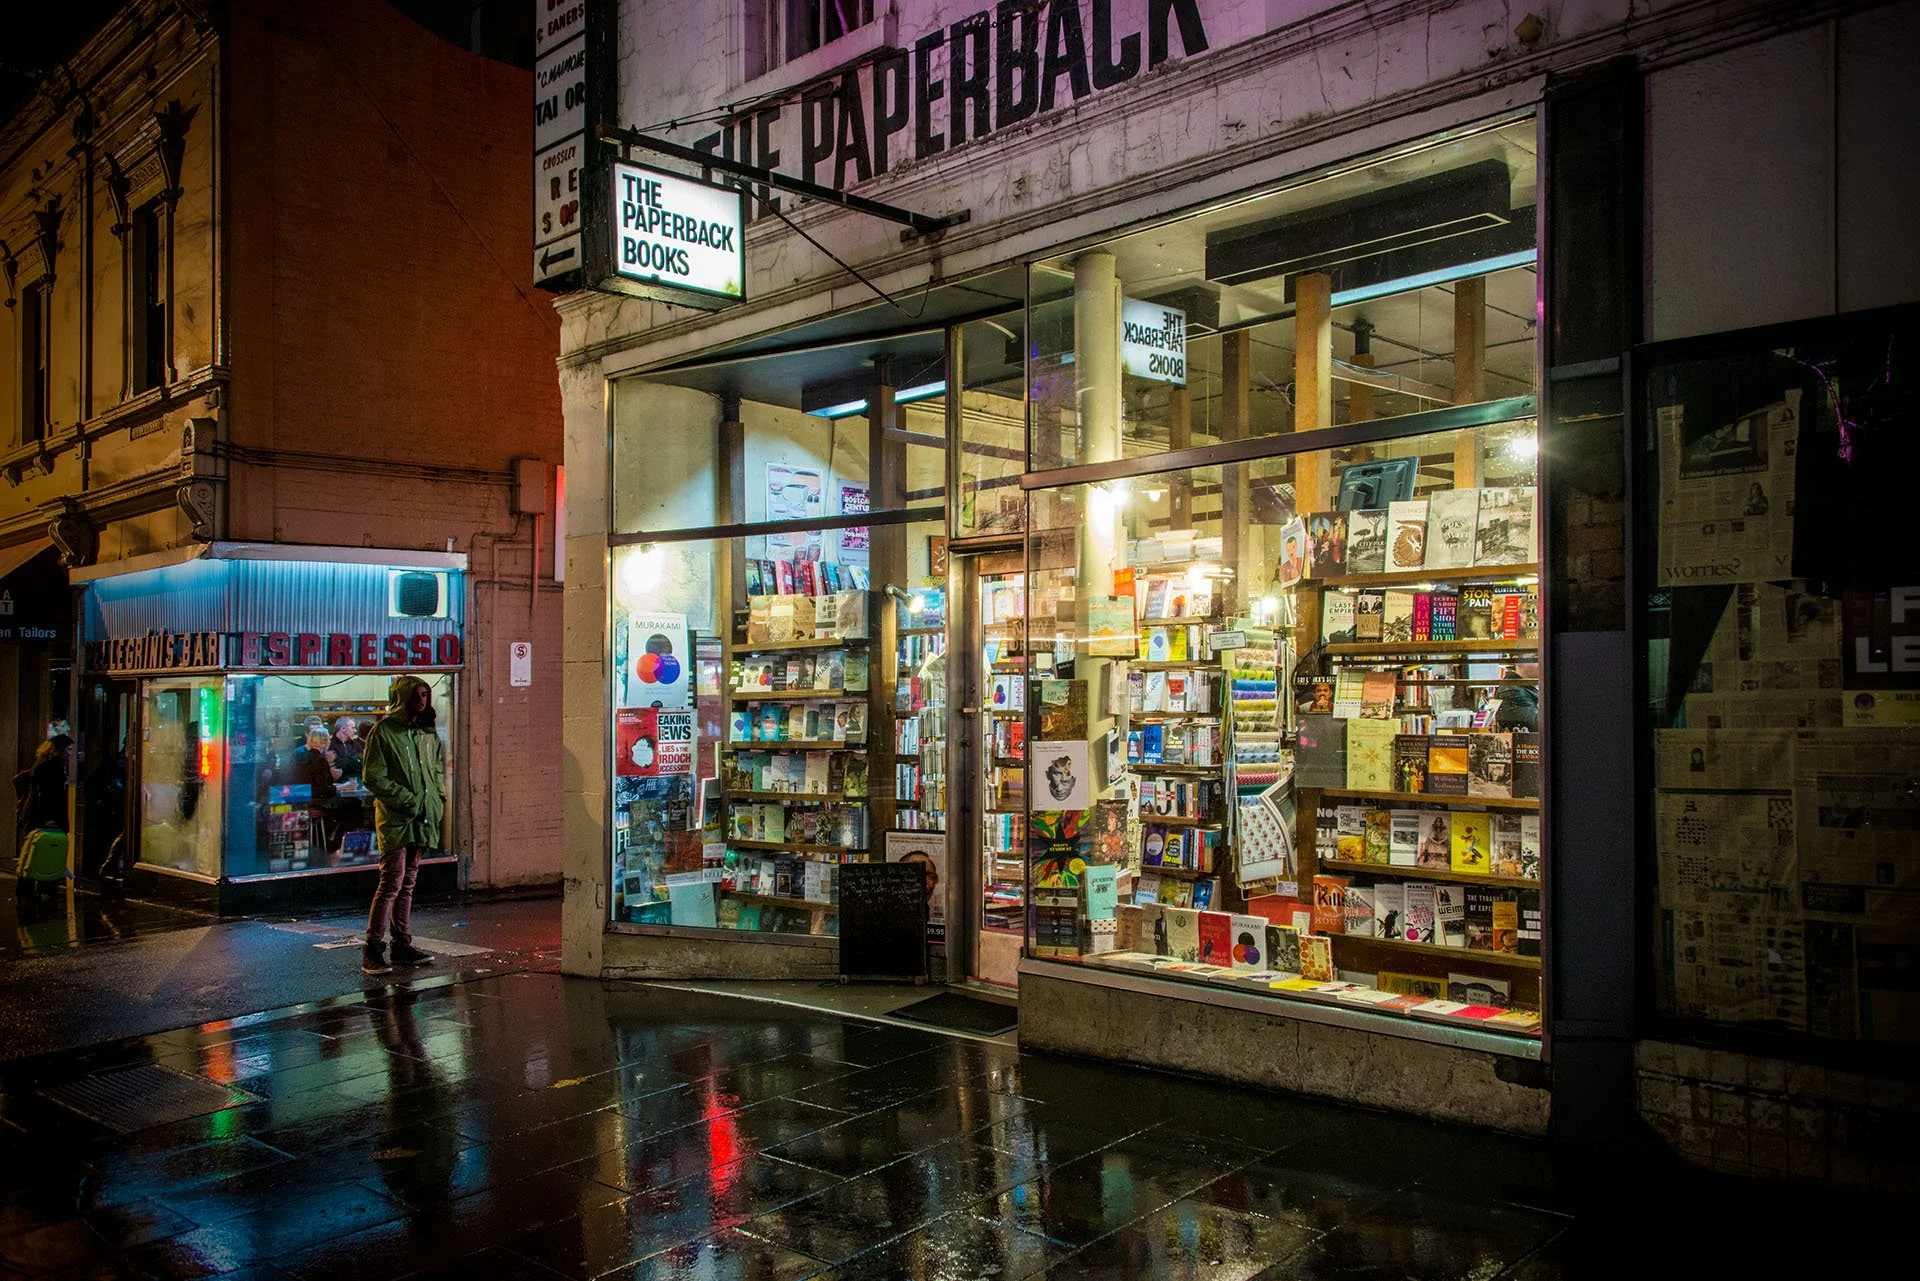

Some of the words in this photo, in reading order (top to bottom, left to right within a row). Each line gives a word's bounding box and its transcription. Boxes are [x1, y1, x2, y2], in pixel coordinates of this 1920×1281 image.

[801, 0, 1209, 202] PAPERBACK
[622, 173, 663, 209] THE
[622, 200, 734, 252] PAPERBACK
[623, 236, 690, 276] BOOKS
[1665, 558, 1741, 578] worries?
[18, 626, 57, 638] Tailors
[635, 621, 681, 630] MURAKAMI
[179, 631, 218, 668] BAR
[241, 631, 461, 667] ESPRESSO
[1314, 882, 1328, 891] The
